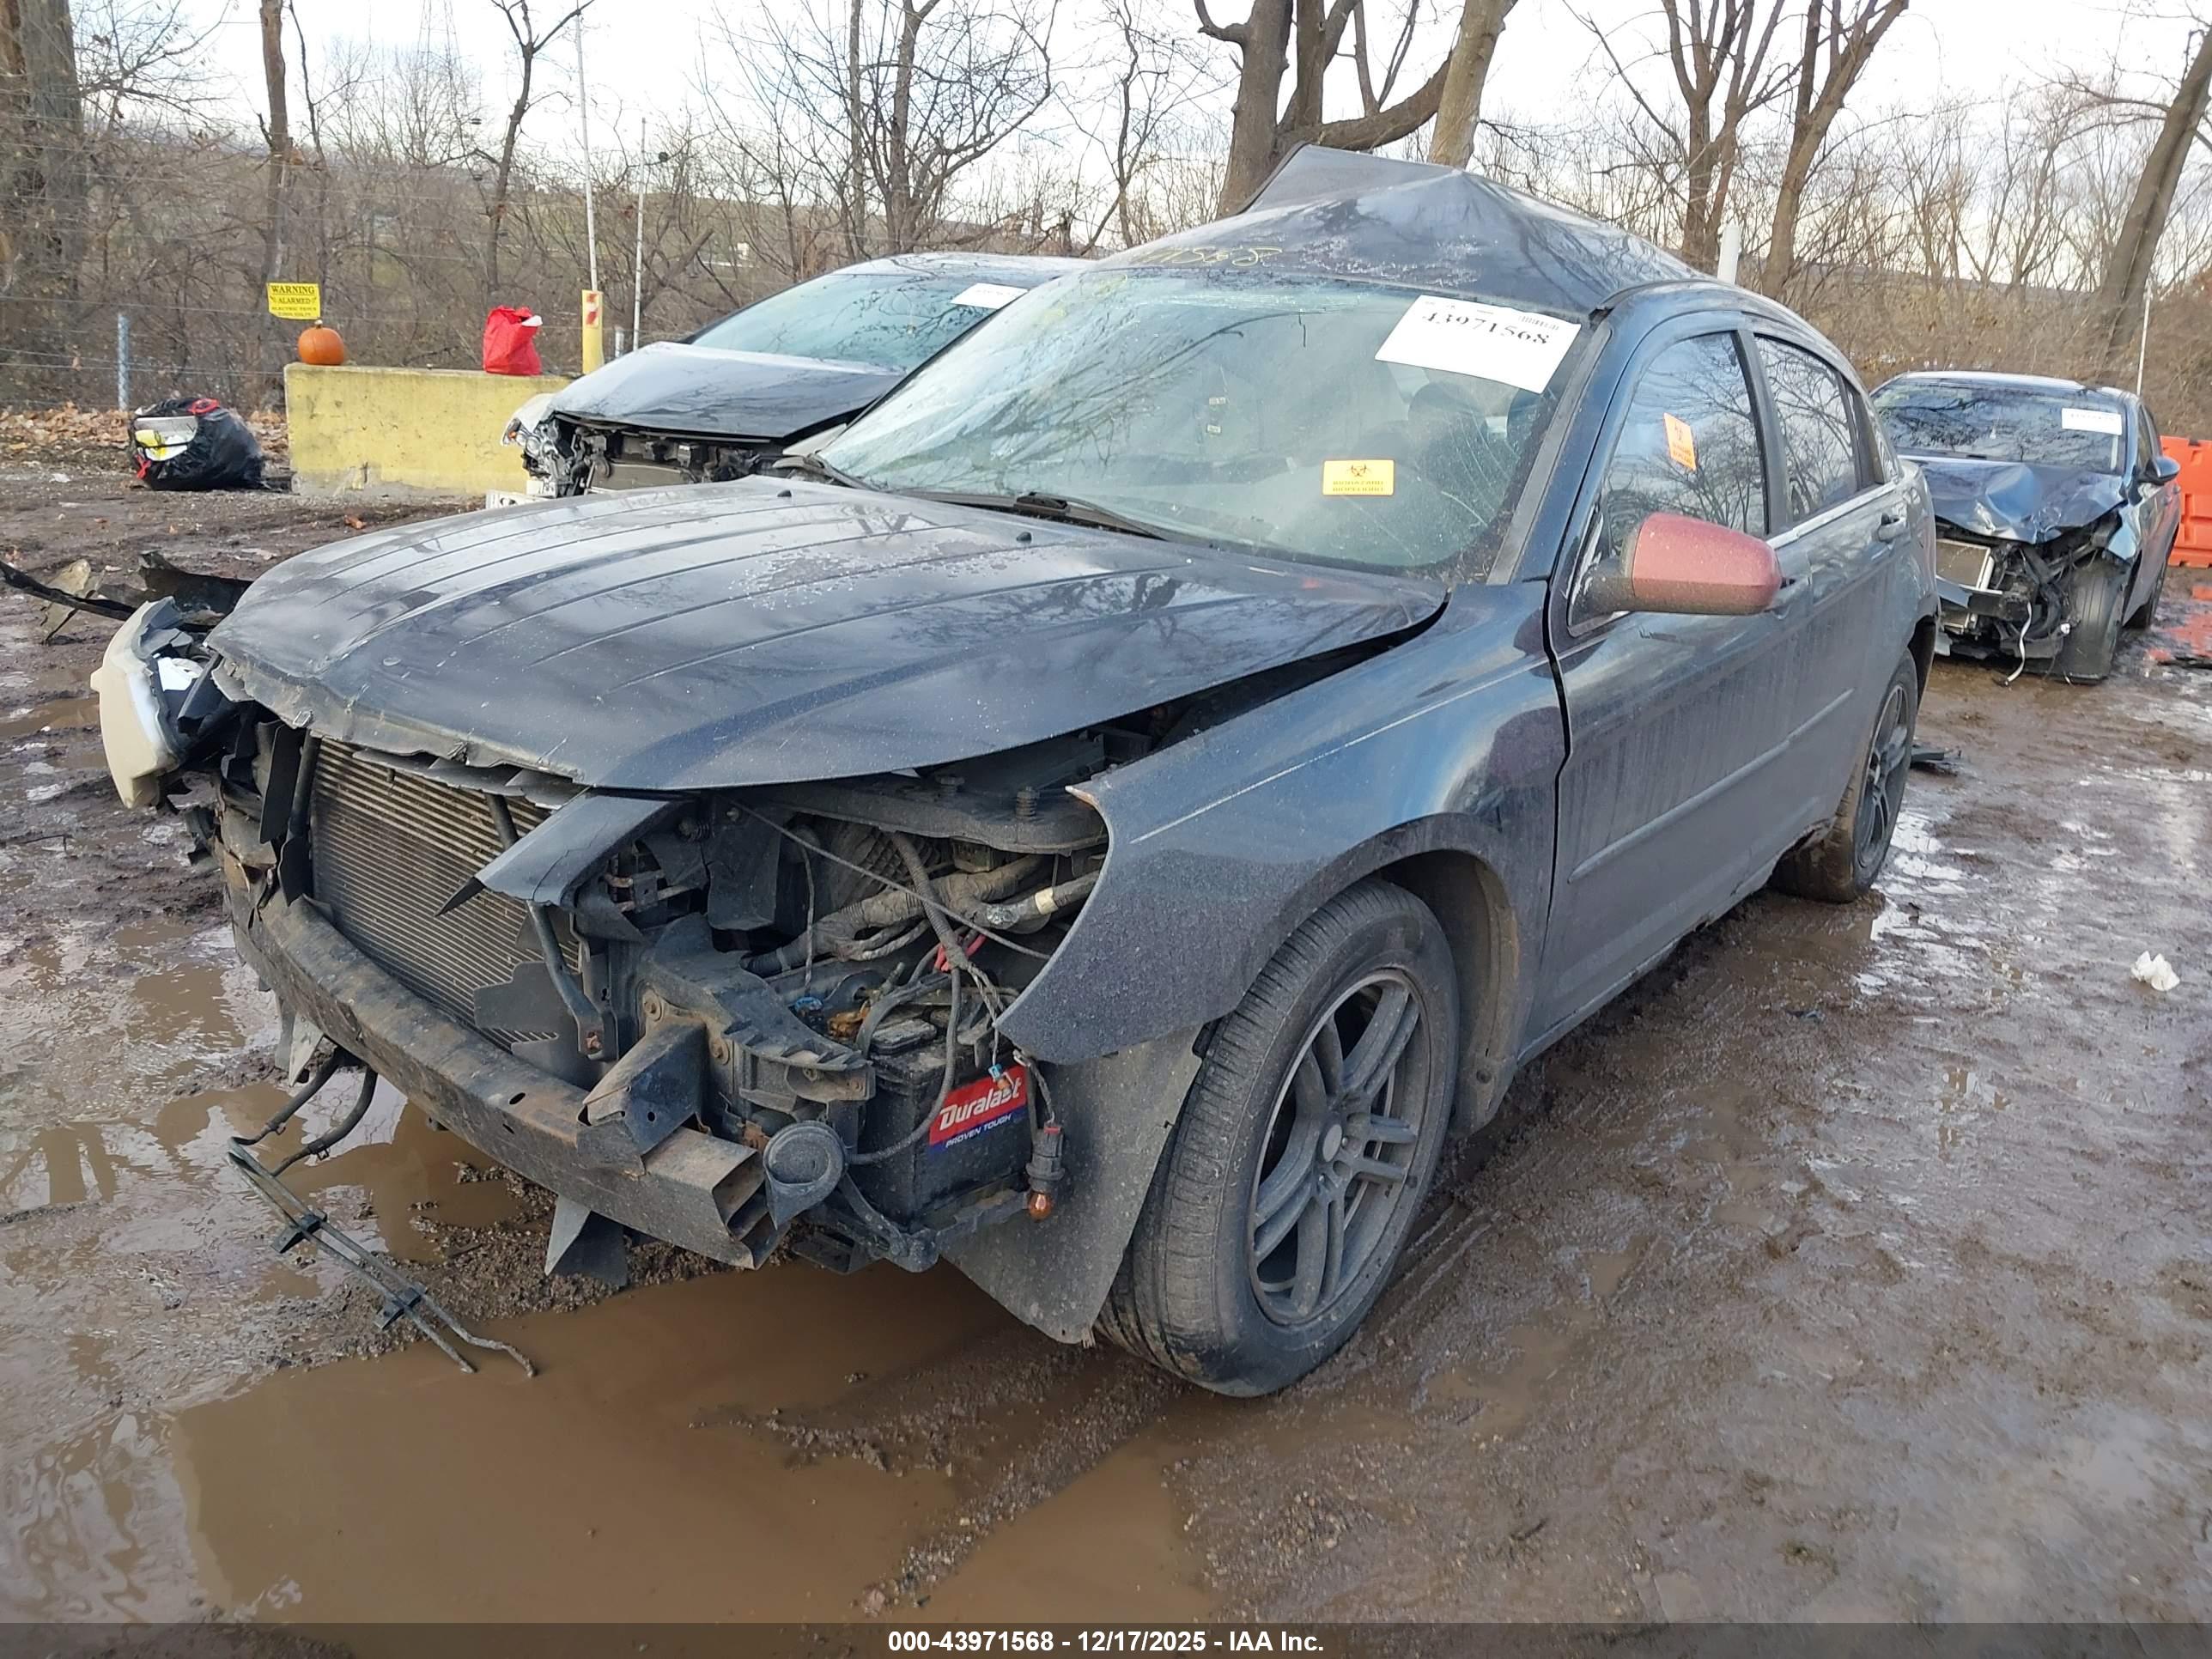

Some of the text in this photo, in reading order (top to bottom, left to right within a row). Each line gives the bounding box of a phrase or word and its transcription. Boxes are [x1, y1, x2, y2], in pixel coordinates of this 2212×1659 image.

[270, 285, 315, 295] WARNING
[939, 1077, 1022, 1131] Duralast
[945, 1114, 1012, 1148] PROVEN TOUGH
